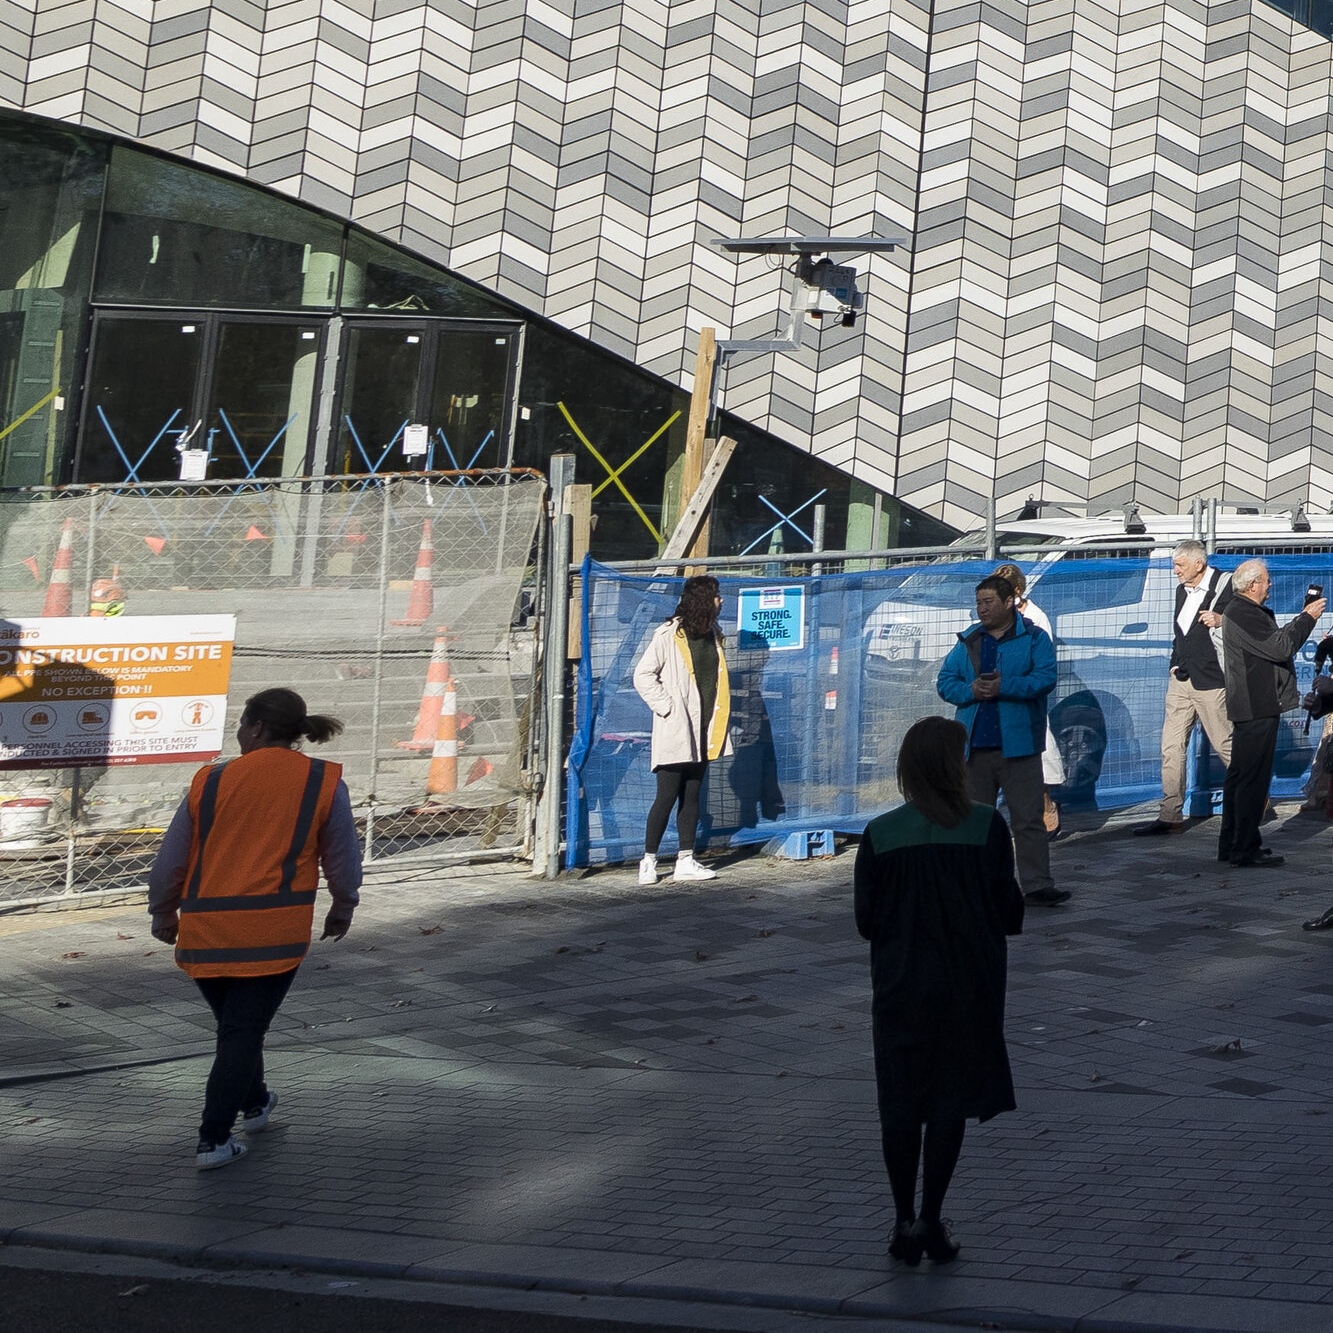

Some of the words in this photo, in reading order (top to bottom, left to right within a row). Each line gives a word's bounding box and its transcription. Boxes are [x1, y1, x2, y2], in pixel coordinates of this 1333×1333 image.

[751, 609, 792, 621] STRONG.
[758, 620, 785, 630] SAFE.
[751, 629, 791, 640] SECURE.
[173, 644, 223, 661] SITE
[43, 668, 84, 677] SHOWN
[85, 666, 119, 675] BELOW
[131, 665, 193, 674] MANDATORY
[51, 674, 92, 683] BEYOND
[116, 673, 147, 681] POINT
[41, 688, 63, 697] NO
[2, 742, 63, 750] PERSONNEL
[65, 739, 122, 748] ACCESSING
[125, 738, 146, 746] THIS
[149, 737, 169, 745] SITE
[62, 747, 101, 756] SIGNED
[166, 743, 197, 751] ENTRY
